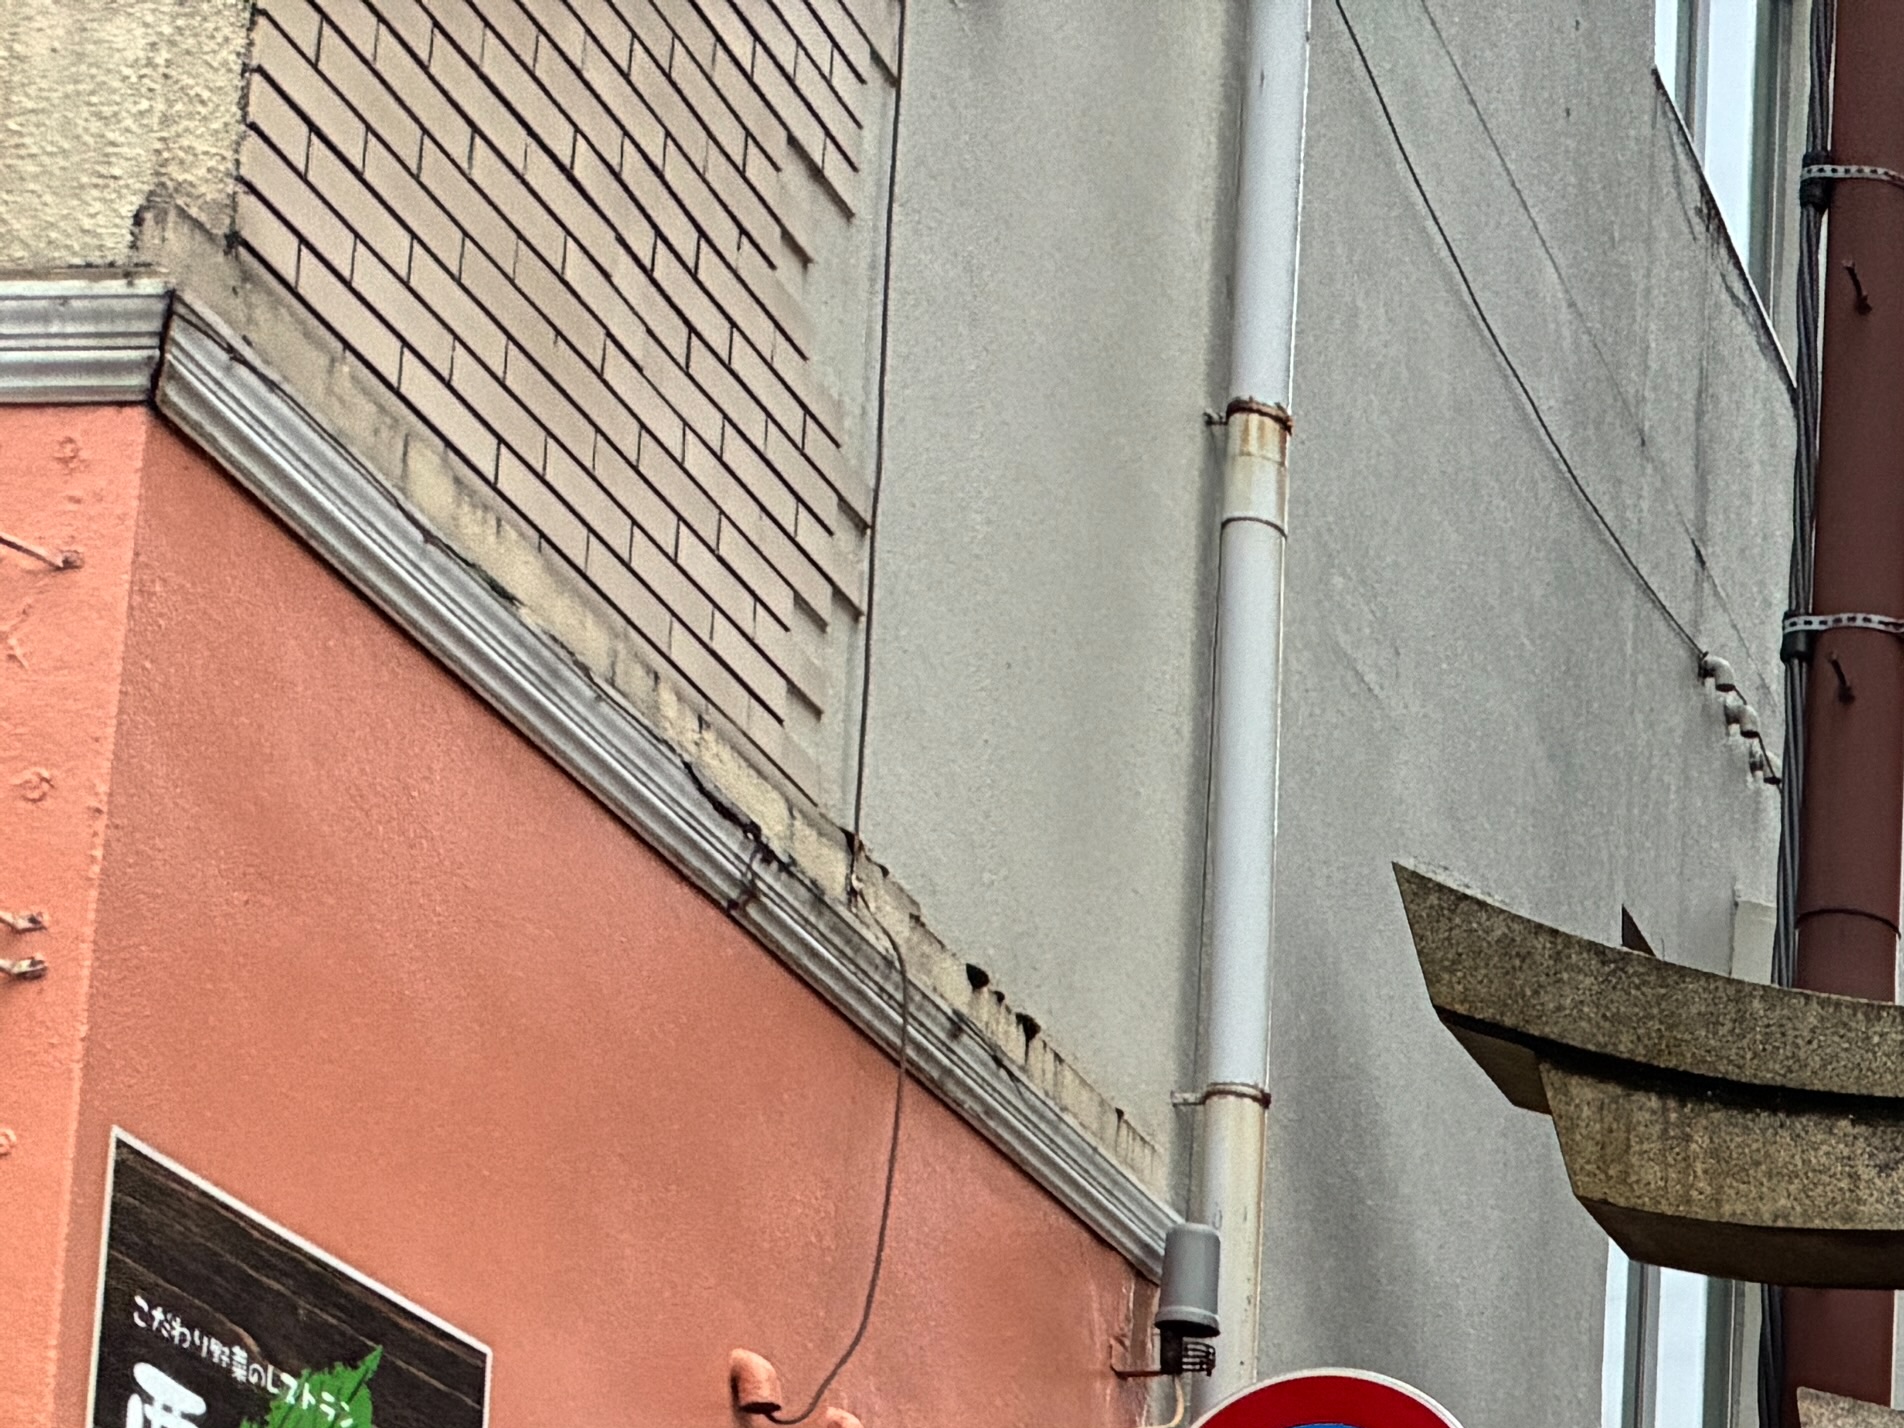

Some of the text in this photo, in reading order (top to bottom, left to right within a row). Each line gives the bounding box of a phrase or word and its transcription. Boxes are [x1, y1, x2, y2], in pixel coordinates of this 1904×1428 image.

[133, 1295, 354, 1428] こだわり野菜のレストラン
